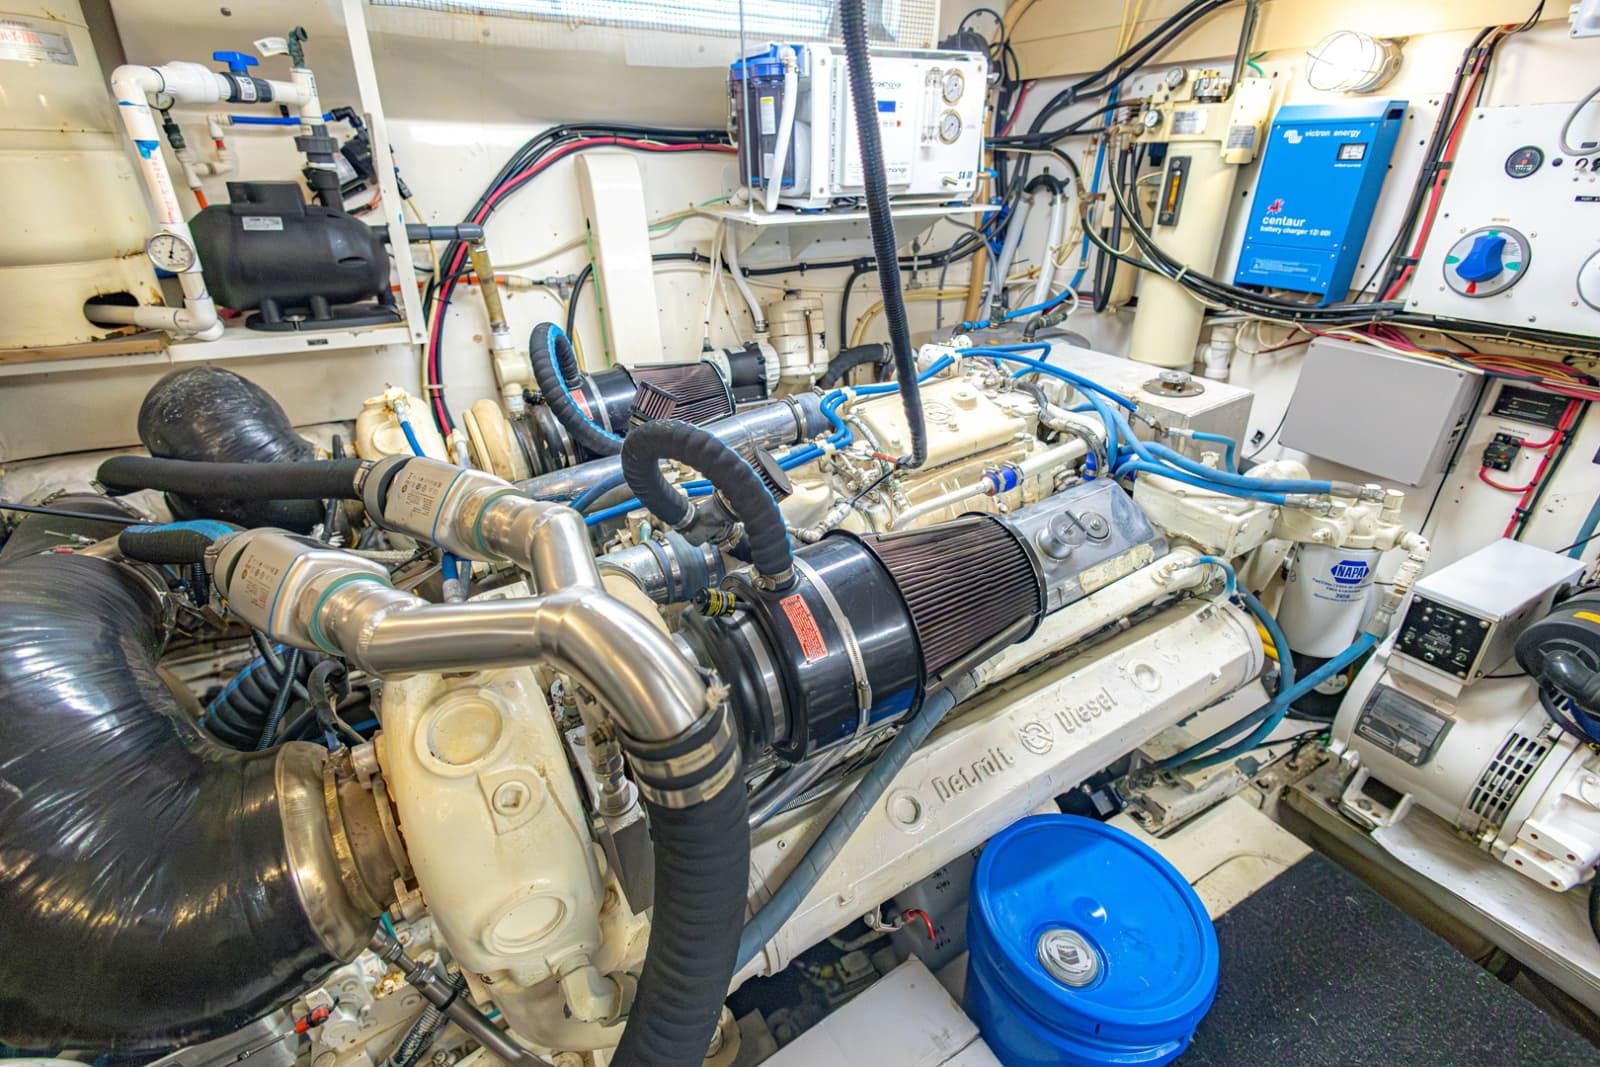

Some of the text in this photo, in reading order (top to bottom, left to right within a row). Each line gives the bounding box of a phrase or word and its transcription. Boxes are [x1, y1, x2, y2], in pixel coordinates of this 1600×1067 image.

[1304, 129, 1361, 138] victron energy
[1262, 216, 1306, 227] centaur
[1260, 225, 1281, 234] battery
[1282, 226, 1308, 236] charger
[1336, 565, 1365, 579] NAPA
[931, 687, 1119, 802] Detroit Diesel
